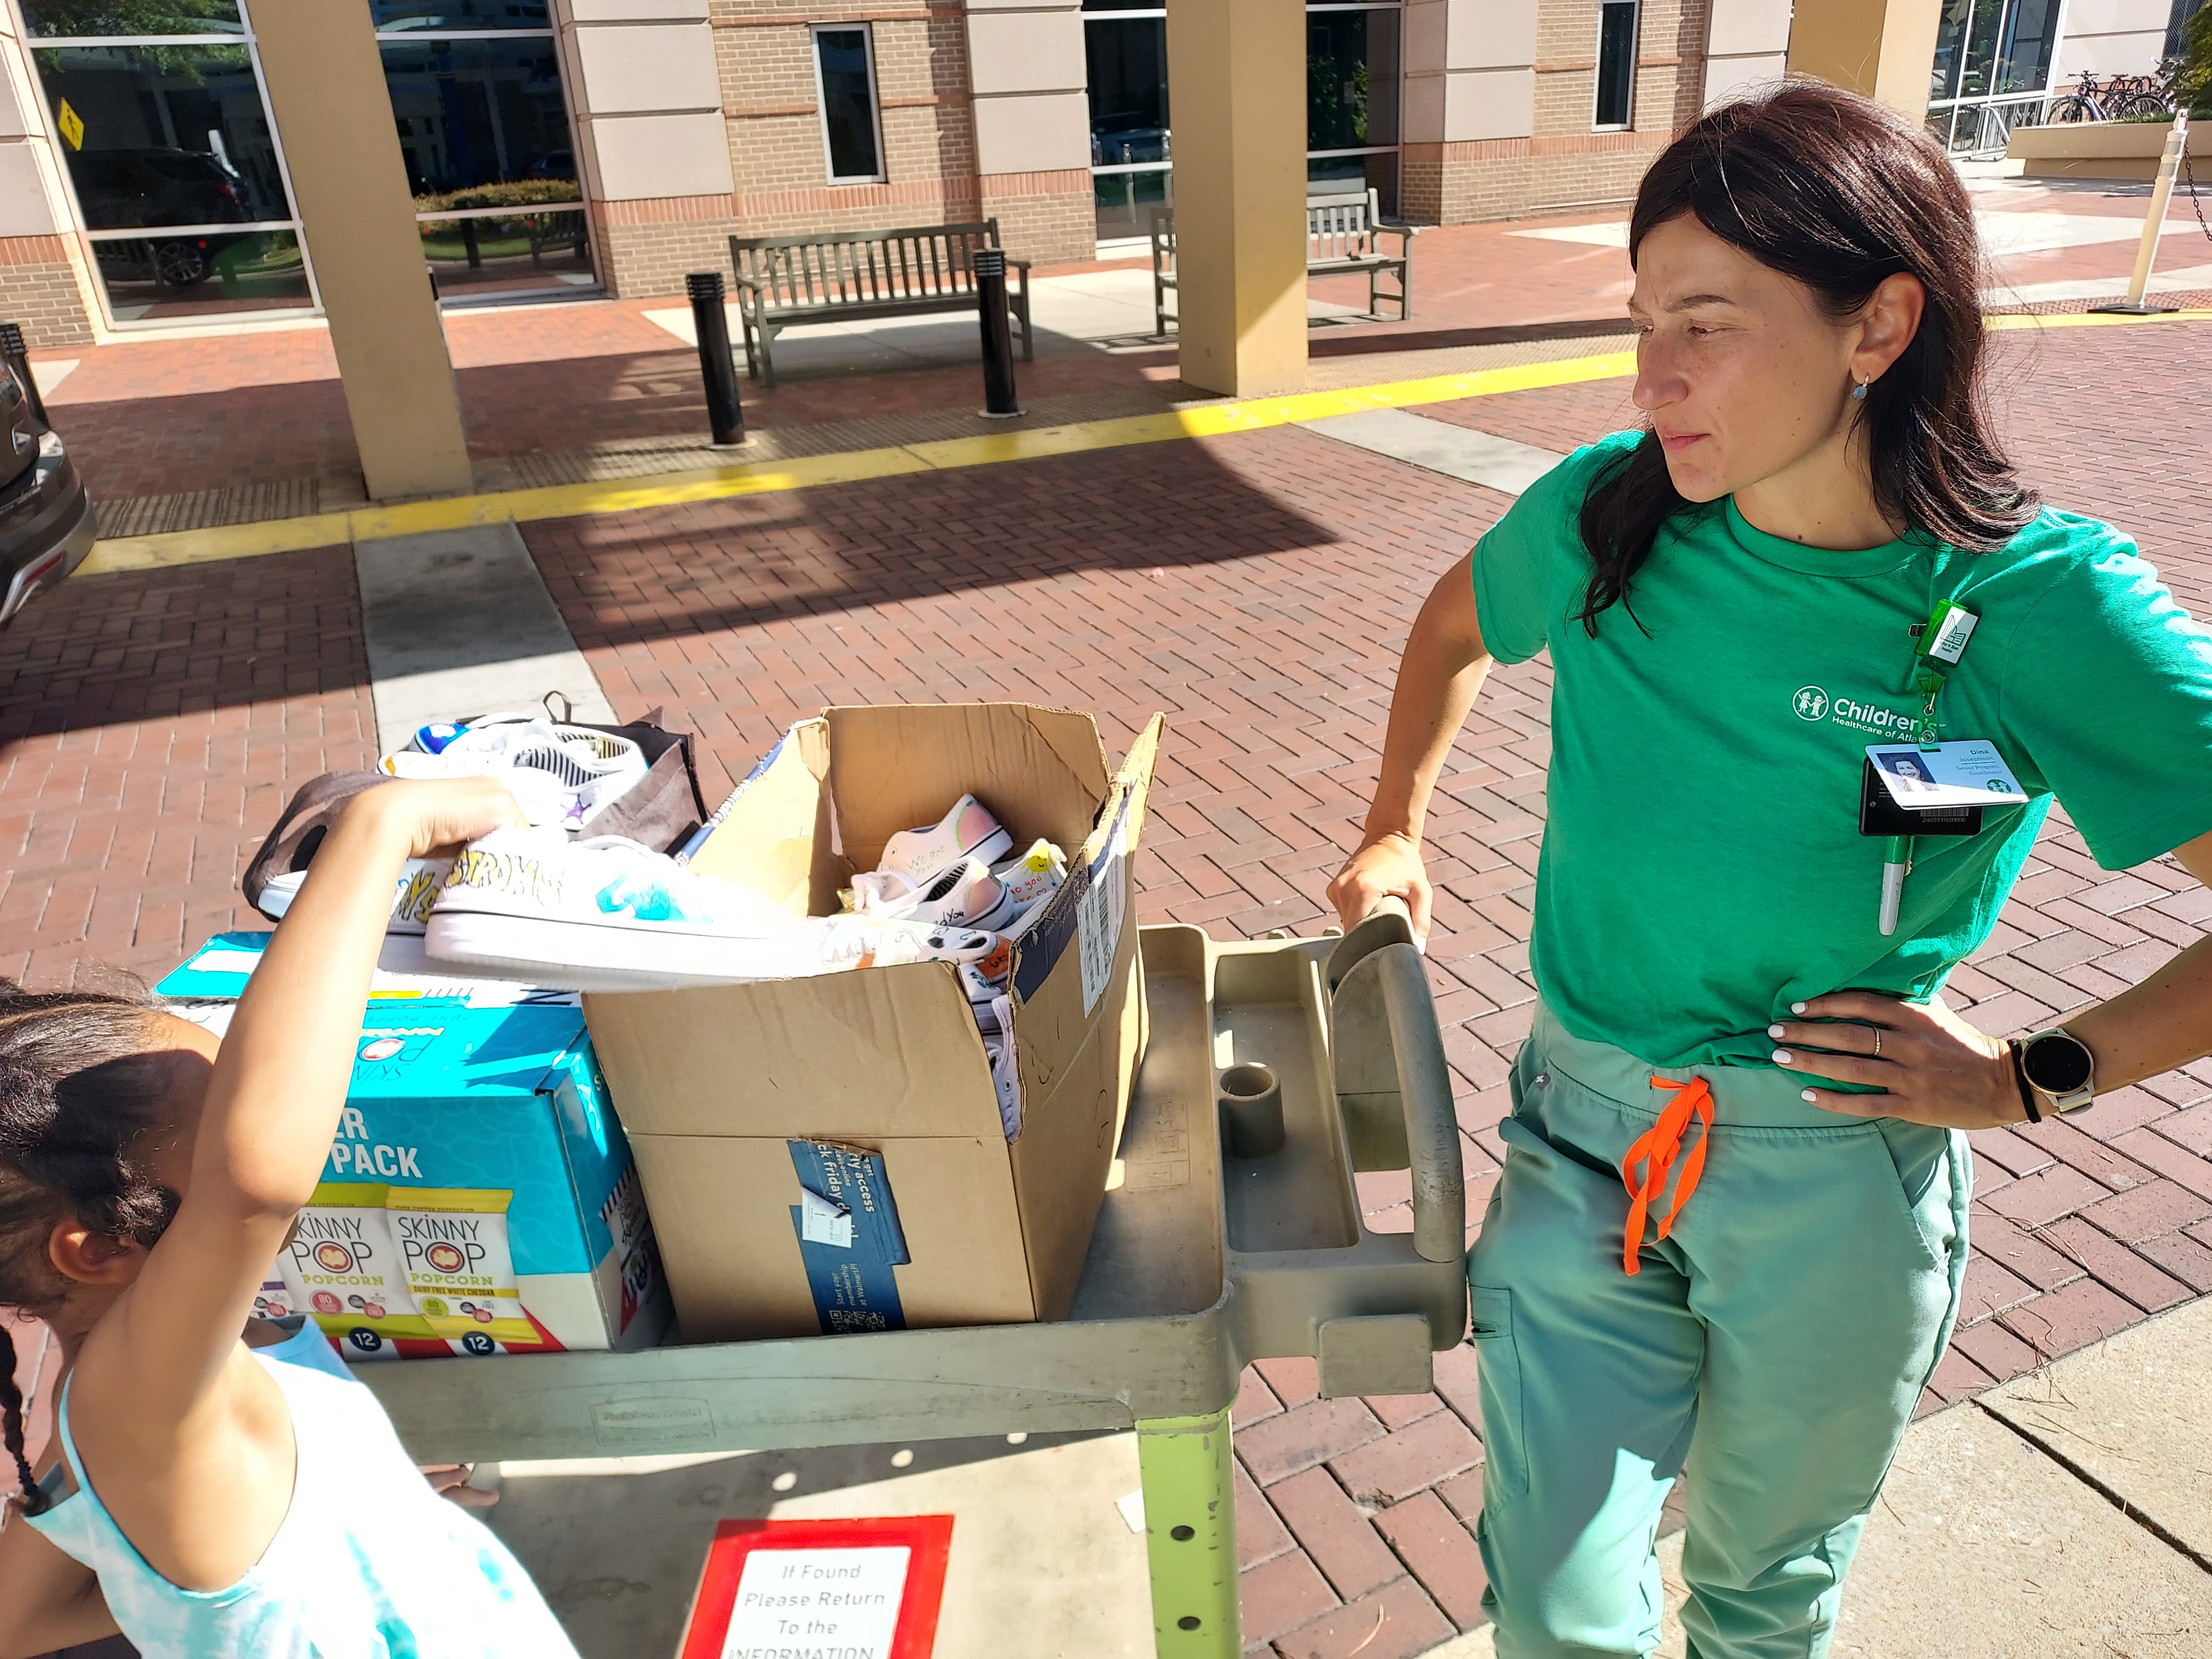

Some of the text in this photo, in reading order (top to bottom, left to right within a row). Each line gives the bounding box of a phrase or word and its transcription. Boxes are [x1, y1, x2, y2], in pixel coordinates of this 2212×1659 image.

[1832, 715, 1883, 735] Healthcare
[1885, 730, 1897, 739] of
[1834, 698, 1937, 732] Children's
[905, 846, 944, 869] We got
[330, 1142, 423, 1178] PACK
[864, 1164, 875, 1177] get
[823, 1160, 844, 1199] friday
[854, 1171, 875, 1213] access
[296, 1213, 362, 1240] KINNY
[398, 1214, 479, 1241] SKINNY
[290, 1240, 373, 1274] POP
[402, 1240, 486, 1274] POP
[302, 1274, 384, 1286] POPCORN
[411, 1273, 493, 1286] POPCORN
[831, 1272, 844, 1306] Start your
[840, 1263, 856, 1306] membership
[354, 1332, 376, 1347] 12
[467, 1335, 489, 1352] 12
[782, 1564, 862, 1579] If Found
[744, 1591, 885, 1607] Please Return
[778, 1619, 838, 1635] To the
[728, 1646, 874, 1659] INFORMATION
